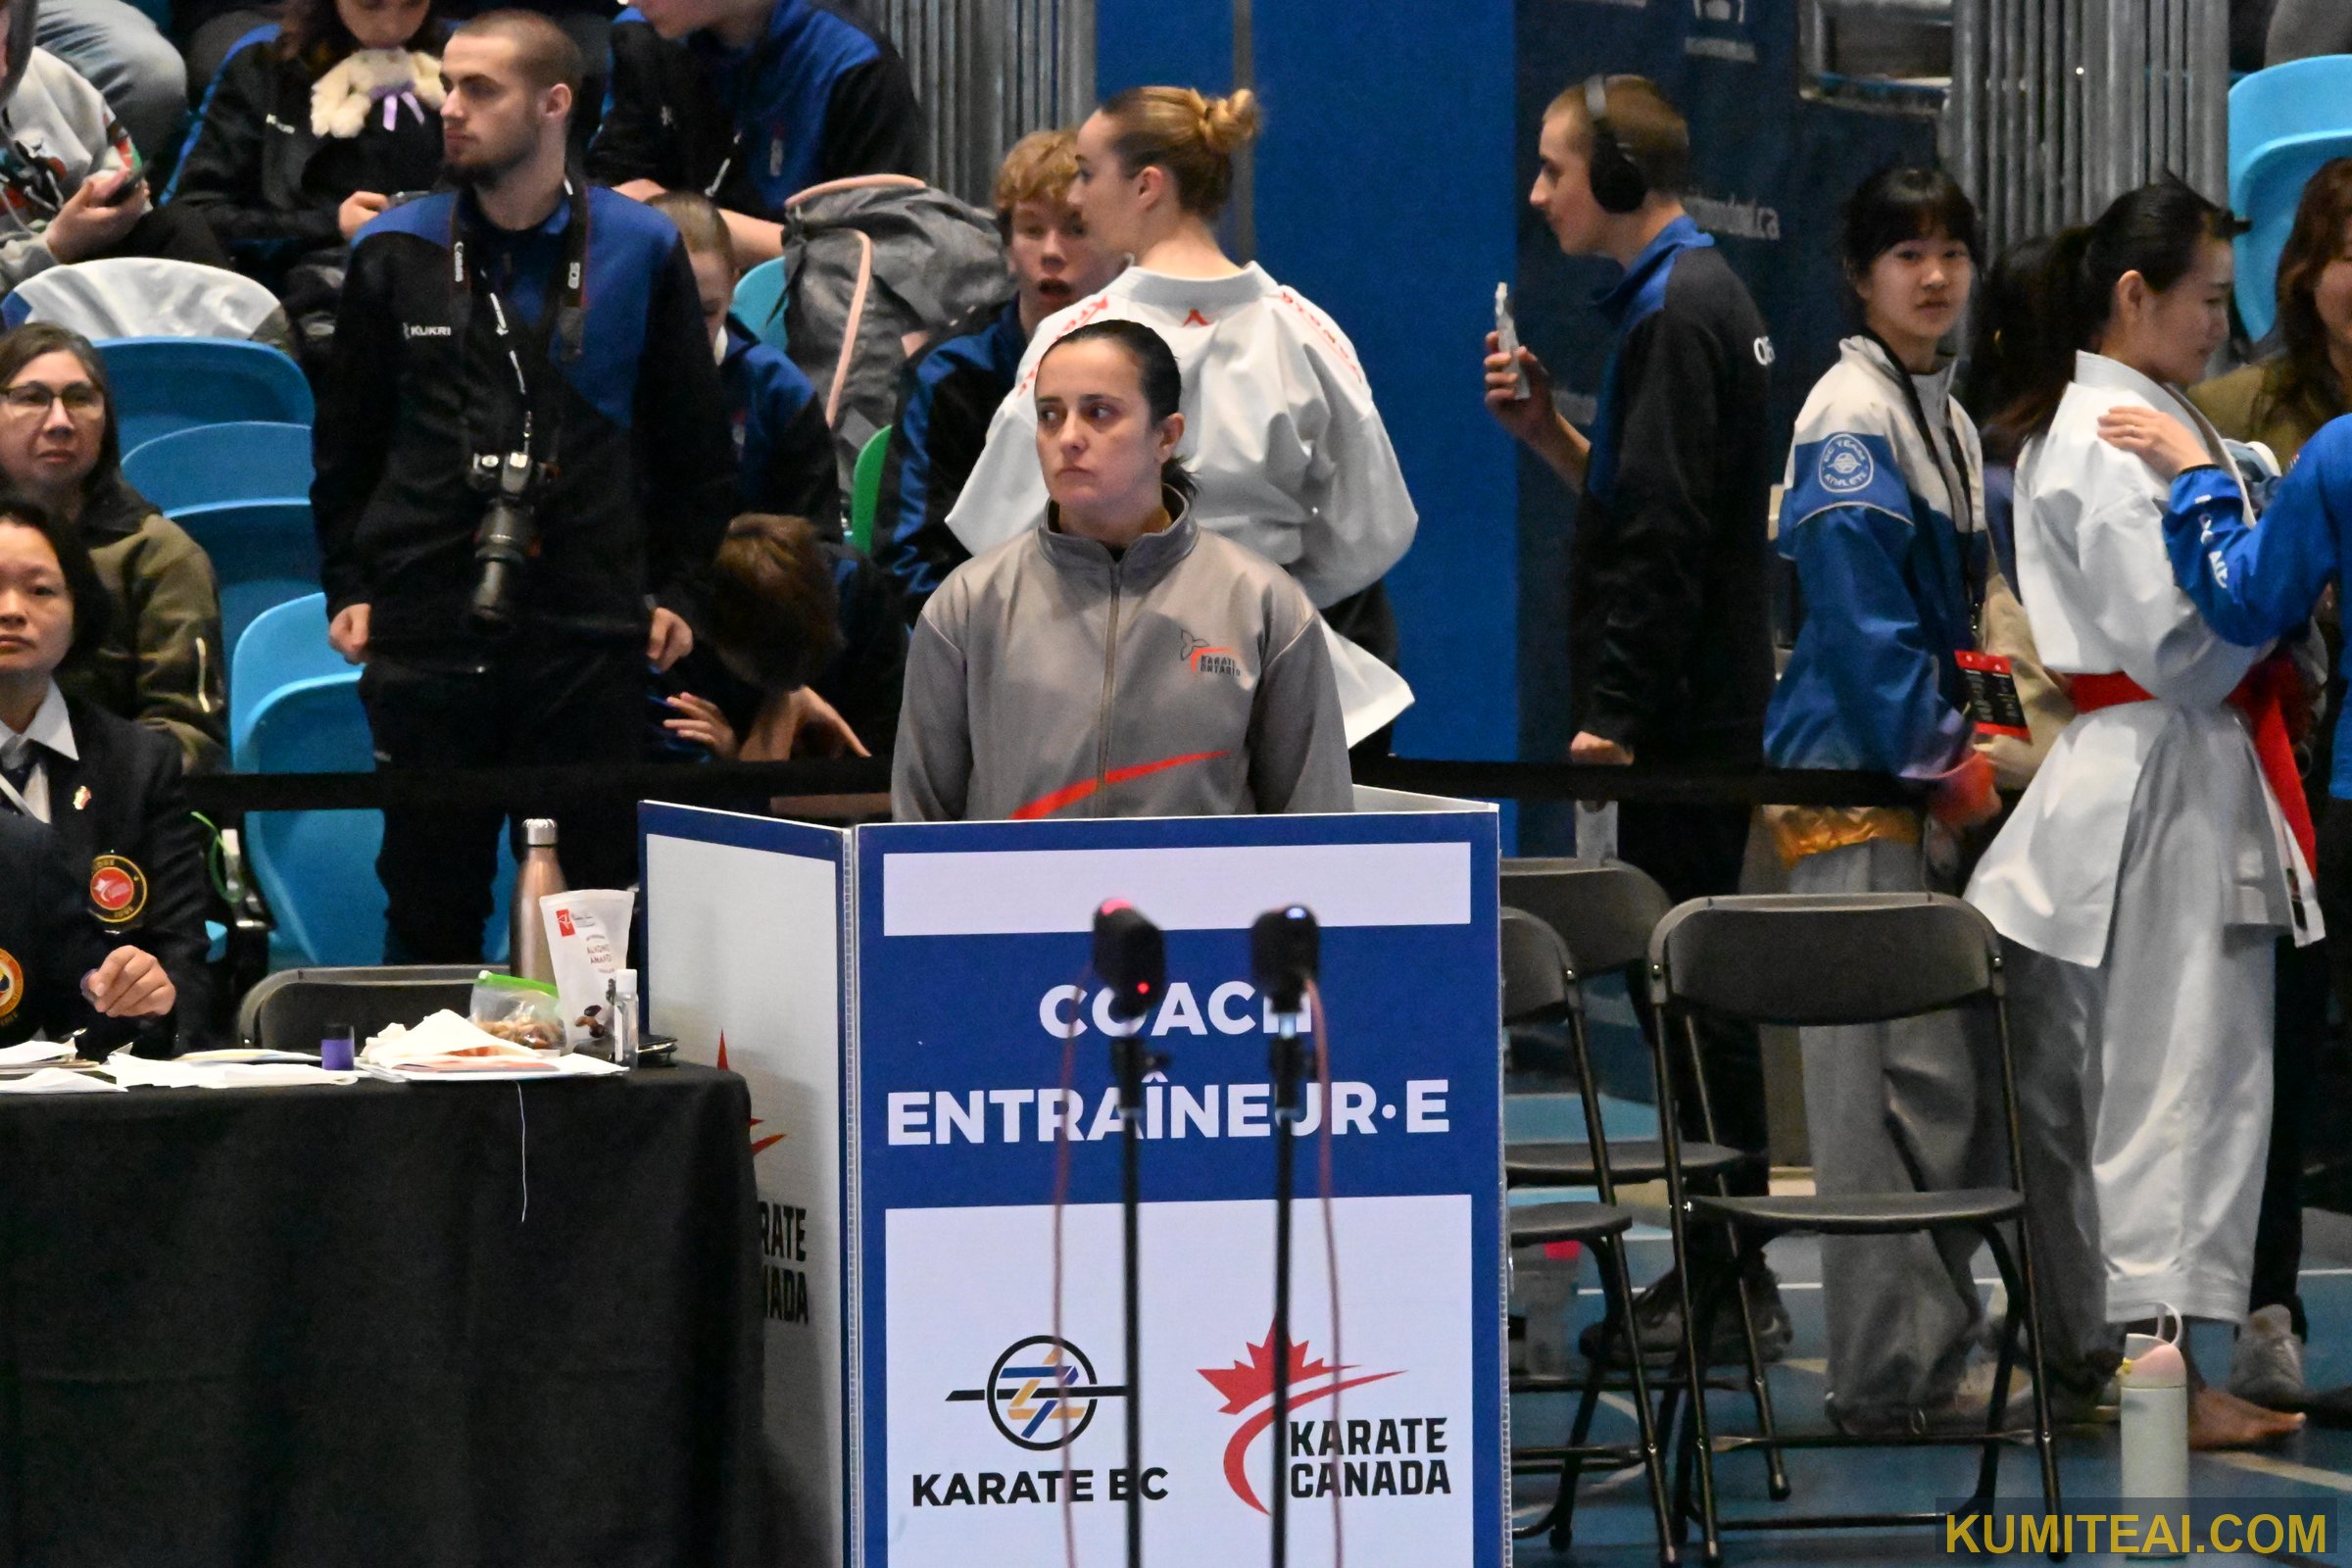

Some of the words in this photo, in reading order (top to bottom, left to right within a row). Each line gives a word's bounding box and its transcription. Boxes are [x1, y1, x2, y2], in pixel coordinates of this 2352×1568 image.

[410, 325, 452, 337] KUKRI
[758, 1200, 807, 1262] RATE
[1289, 1417, 1448, 1457] KARATE
[912, 1469, 1095, 1507] KARATE
[1109, 1466, 1169, 1500] BC
[1289, 1458, 1452, 1498] CANADA
